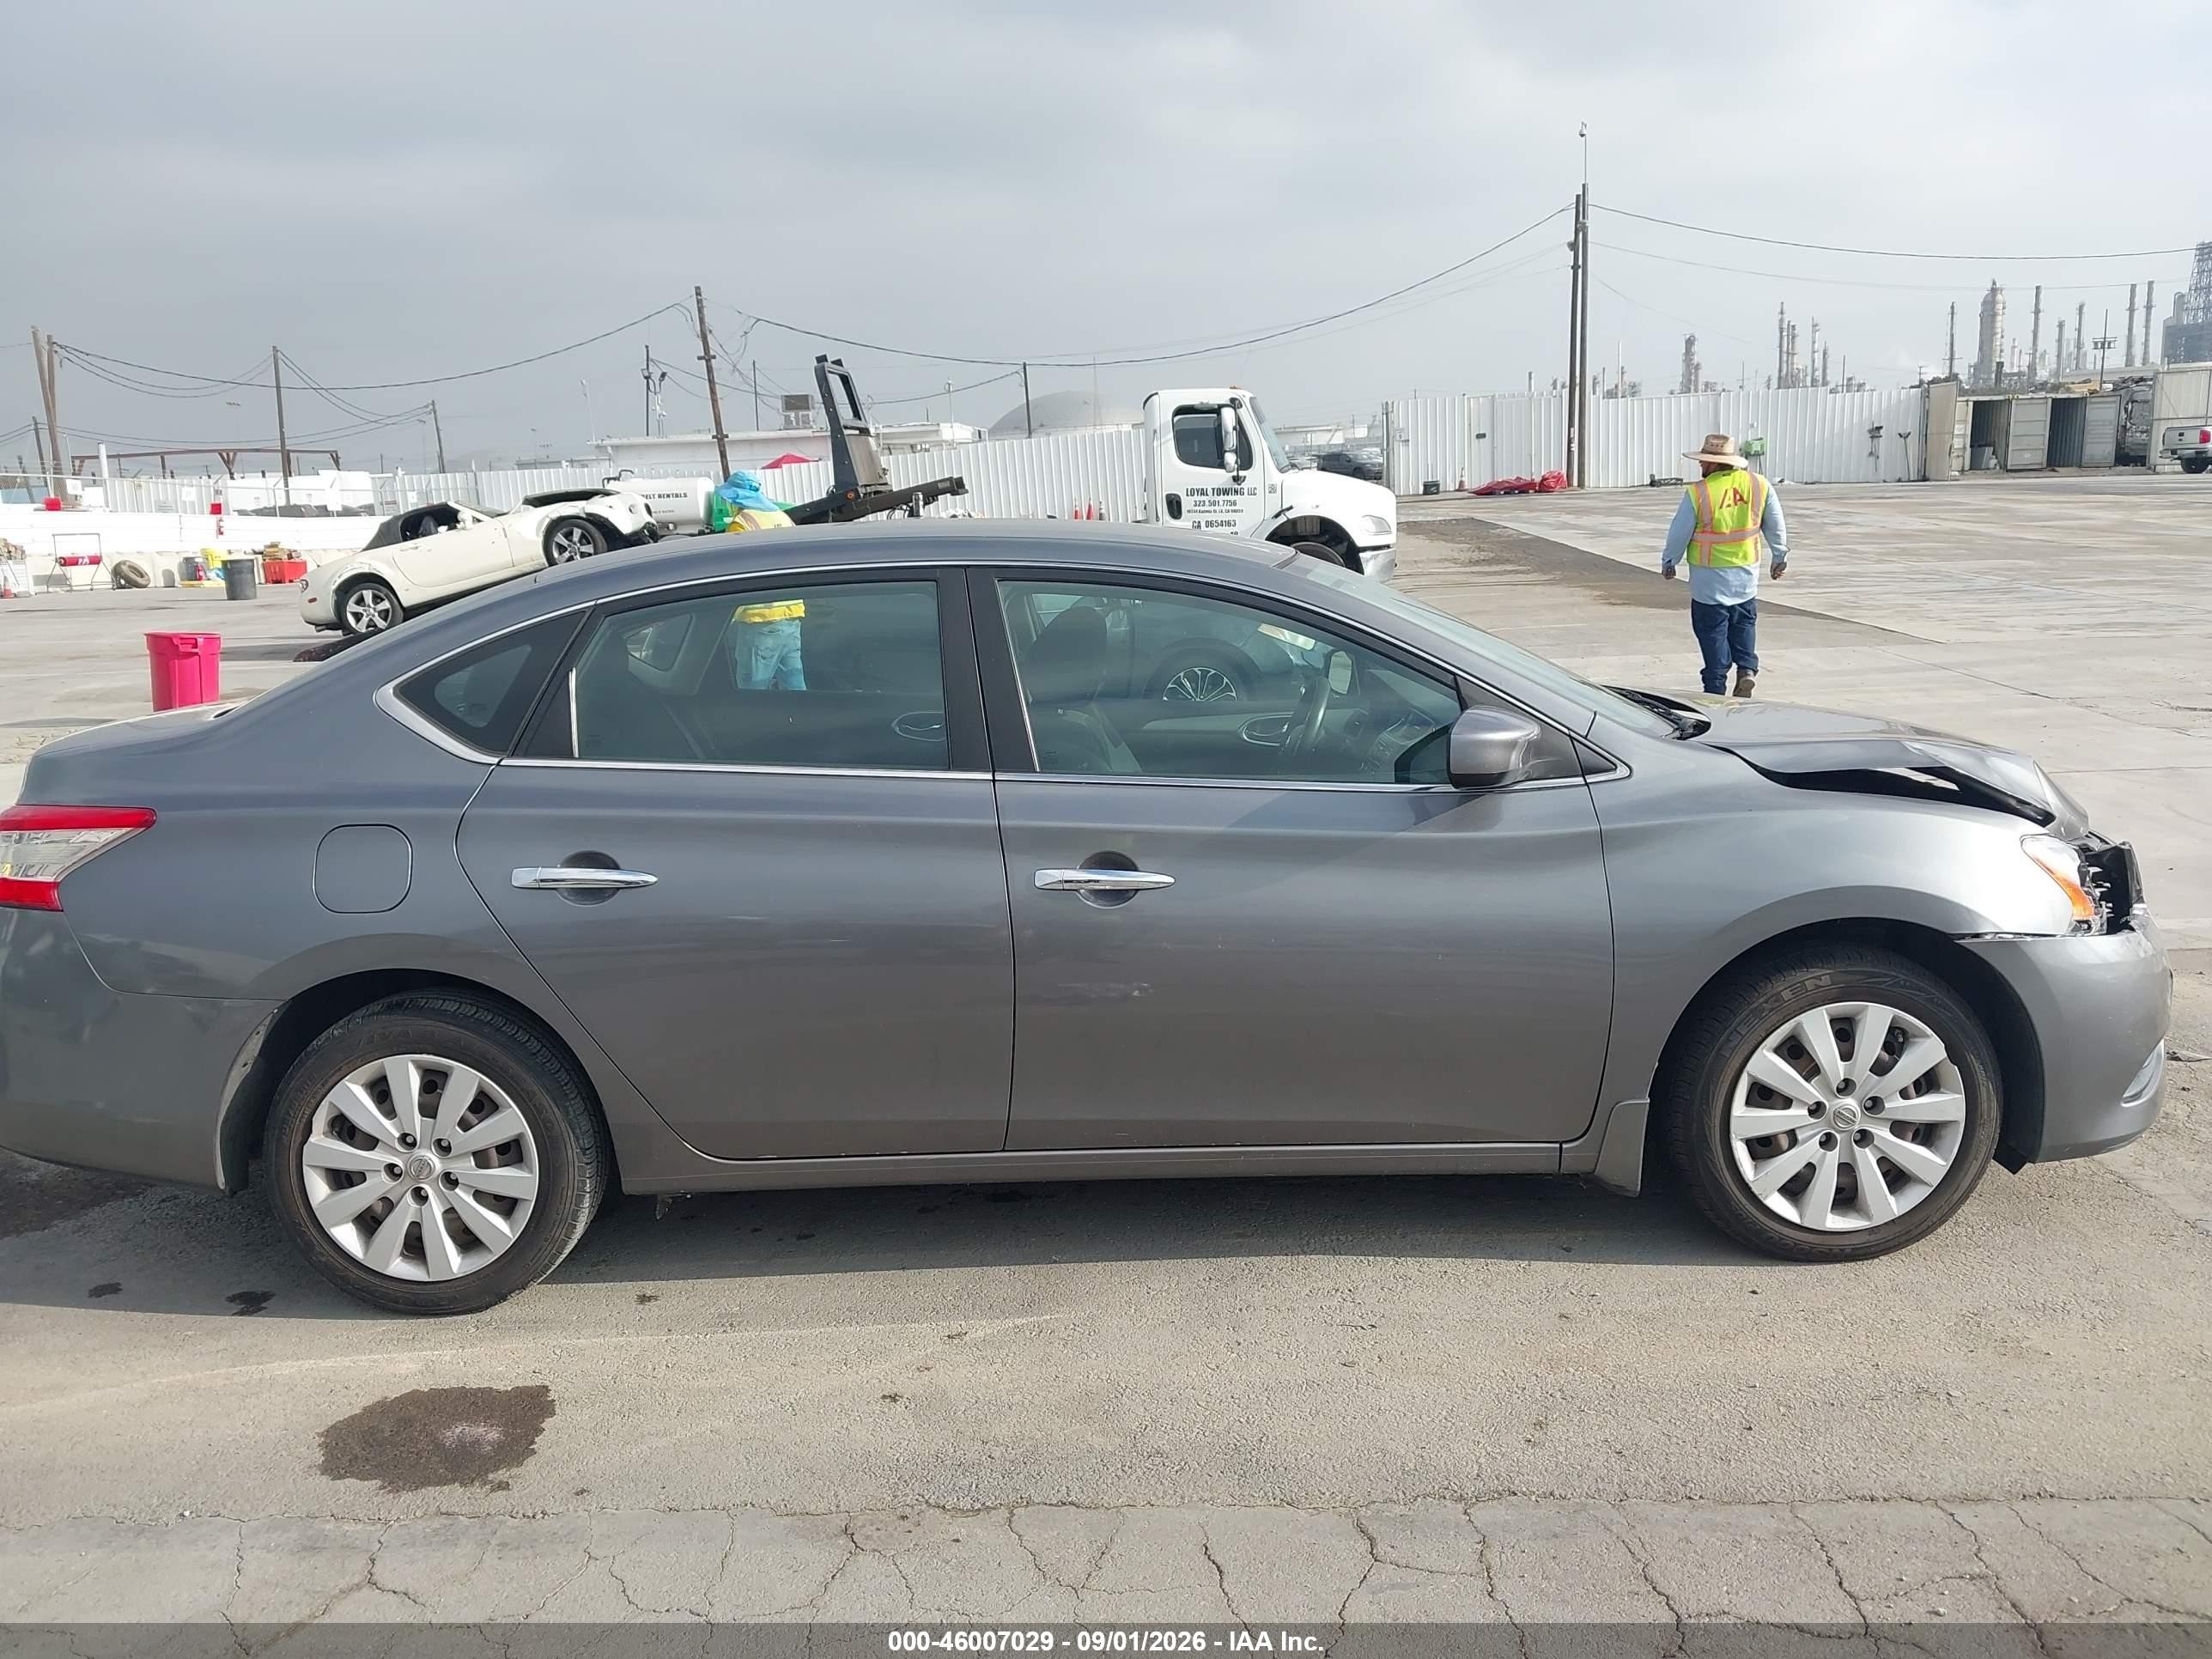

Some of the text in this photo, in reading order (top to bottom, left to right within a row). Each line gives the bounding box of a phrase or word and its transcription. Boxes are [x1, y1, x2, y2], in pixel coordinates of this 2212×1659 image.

[1186, 486, 1258, 497] LOYAL TOWING LLC
[1193, 499, 1237, 507] 323.501.7756
[1192, 519, 1237, 530] CA 0654163
